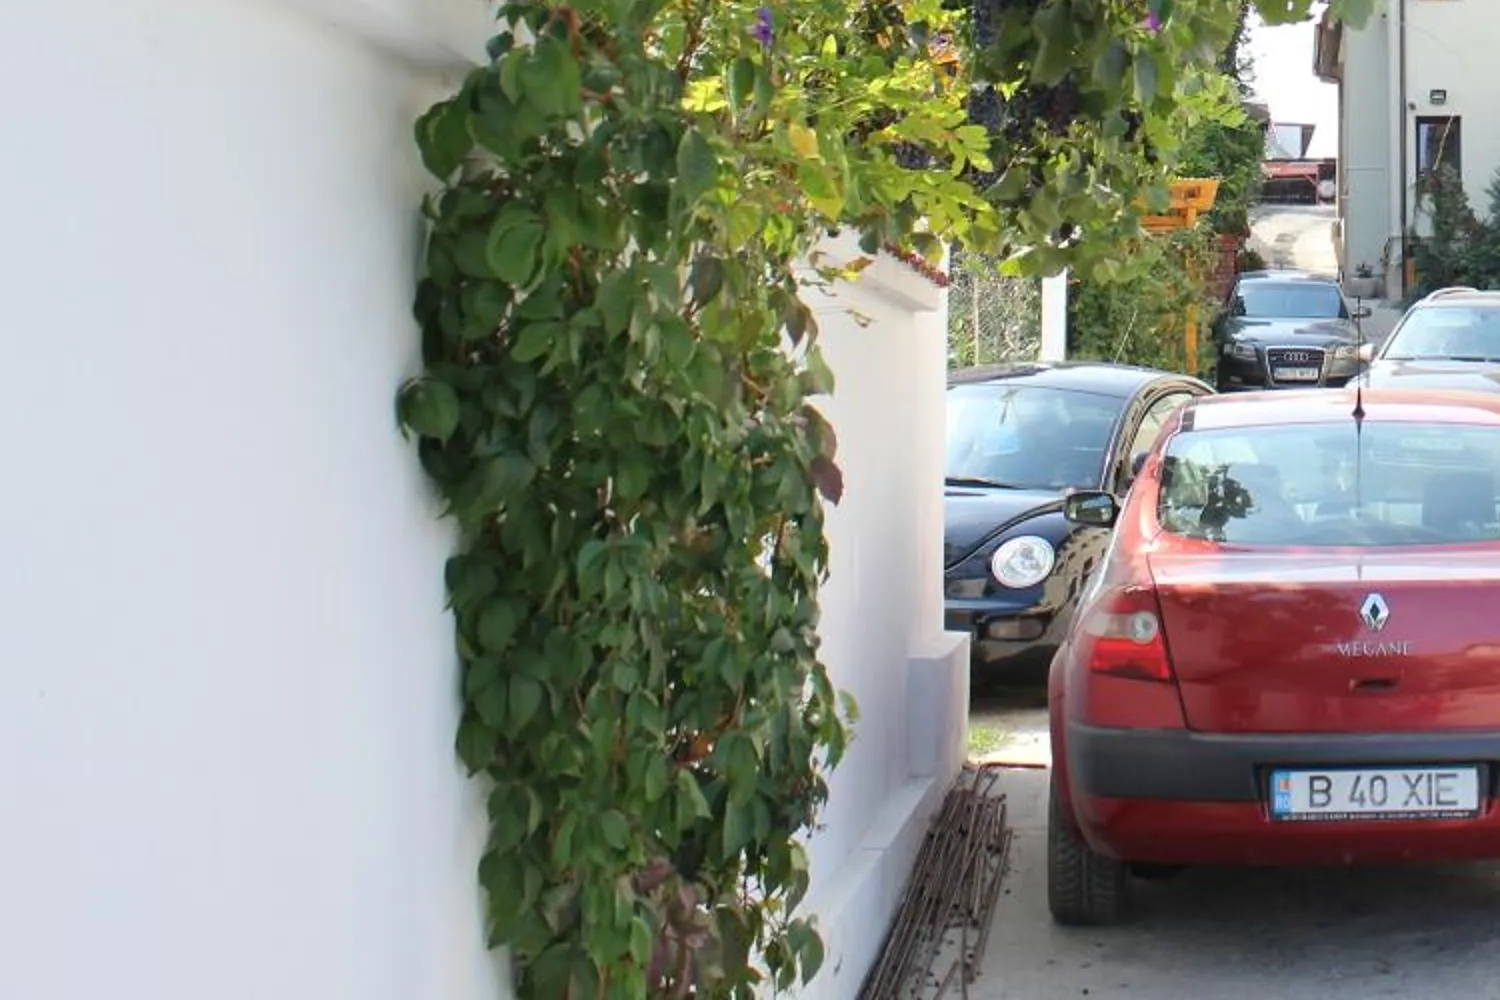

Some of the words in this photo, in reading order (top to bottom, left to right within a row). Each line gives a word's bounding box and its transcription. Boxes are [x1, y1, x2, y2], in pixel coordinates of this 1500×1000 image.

[1308, 775, 1332, 808] B
[1349, 774, 1389, 807] 40
[1401, 773, 1460, 807] XIE
